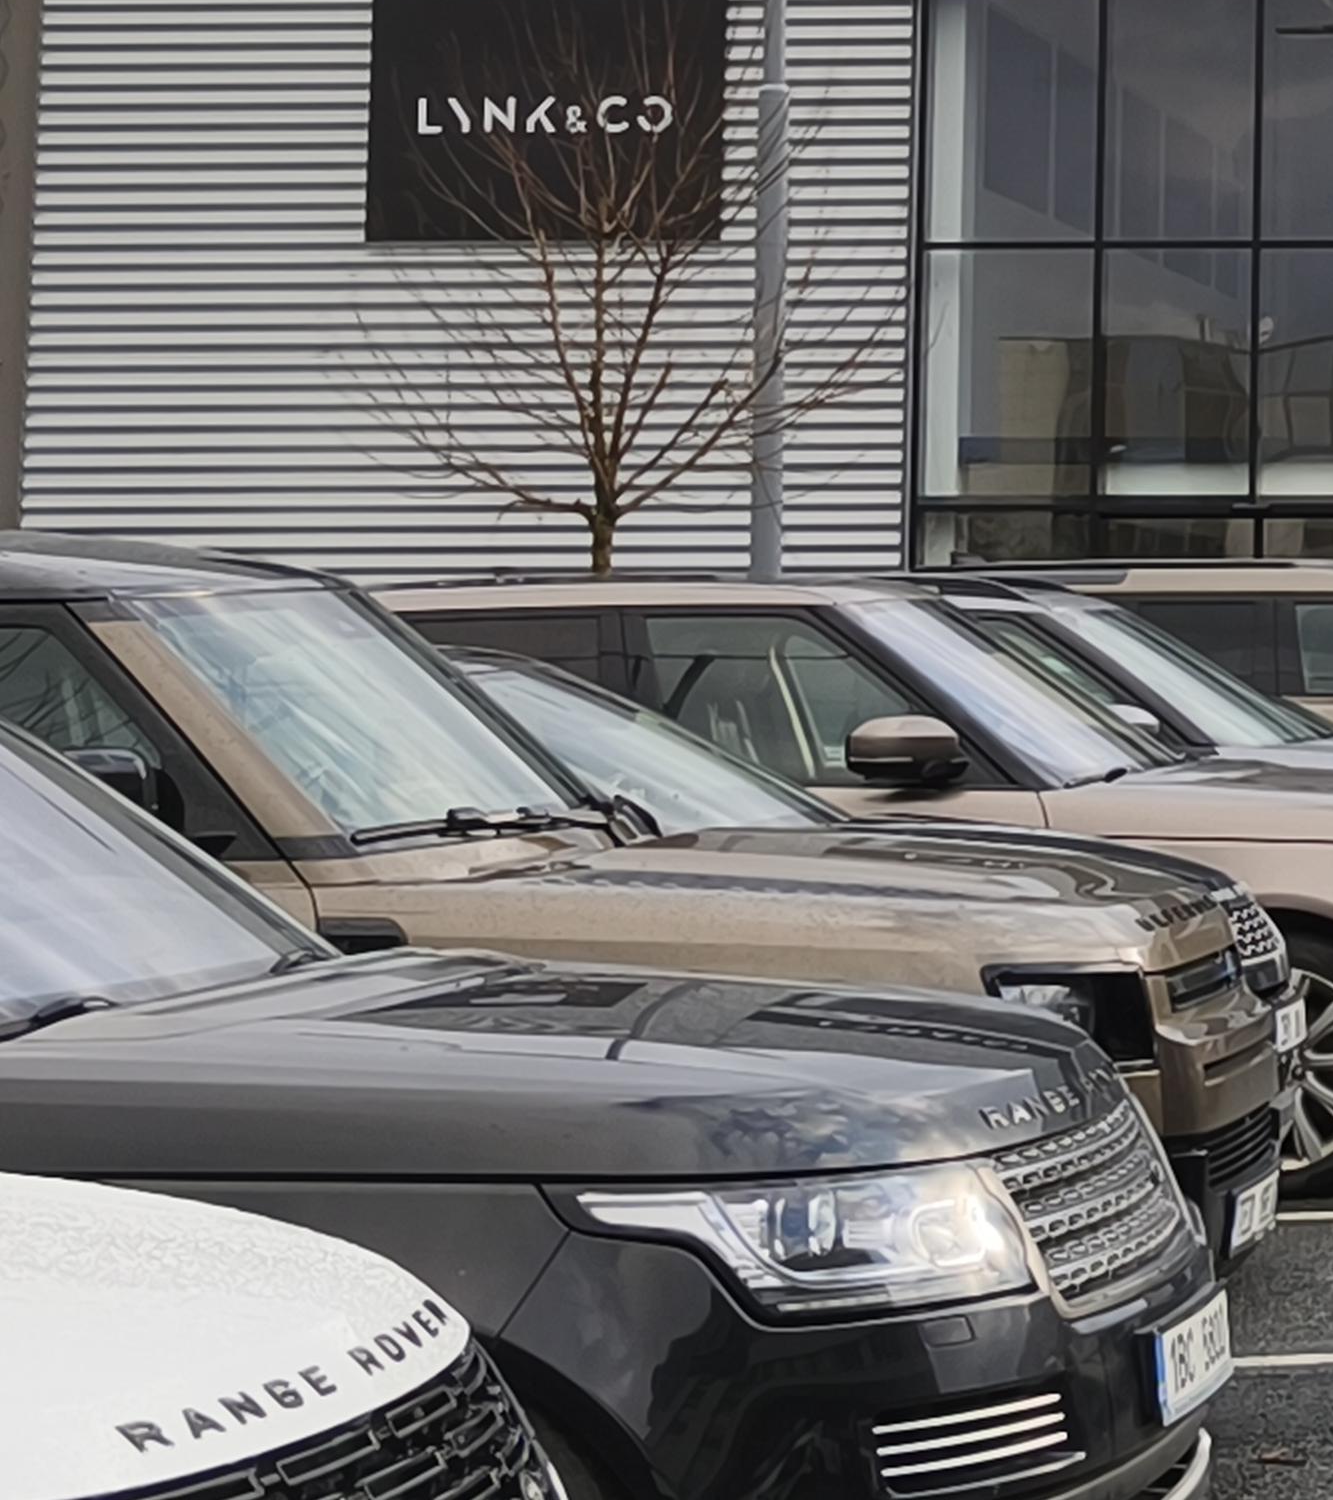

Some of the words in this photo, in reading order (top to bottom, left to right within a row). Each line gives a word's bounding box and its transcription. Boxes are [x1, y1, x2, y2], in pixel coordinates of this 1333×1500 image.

[417, 95, 674, 135] LYNK&CO
[115, 1364, 338, 1453] RANGE
[347, 1298, 449, 1376] ROVER
